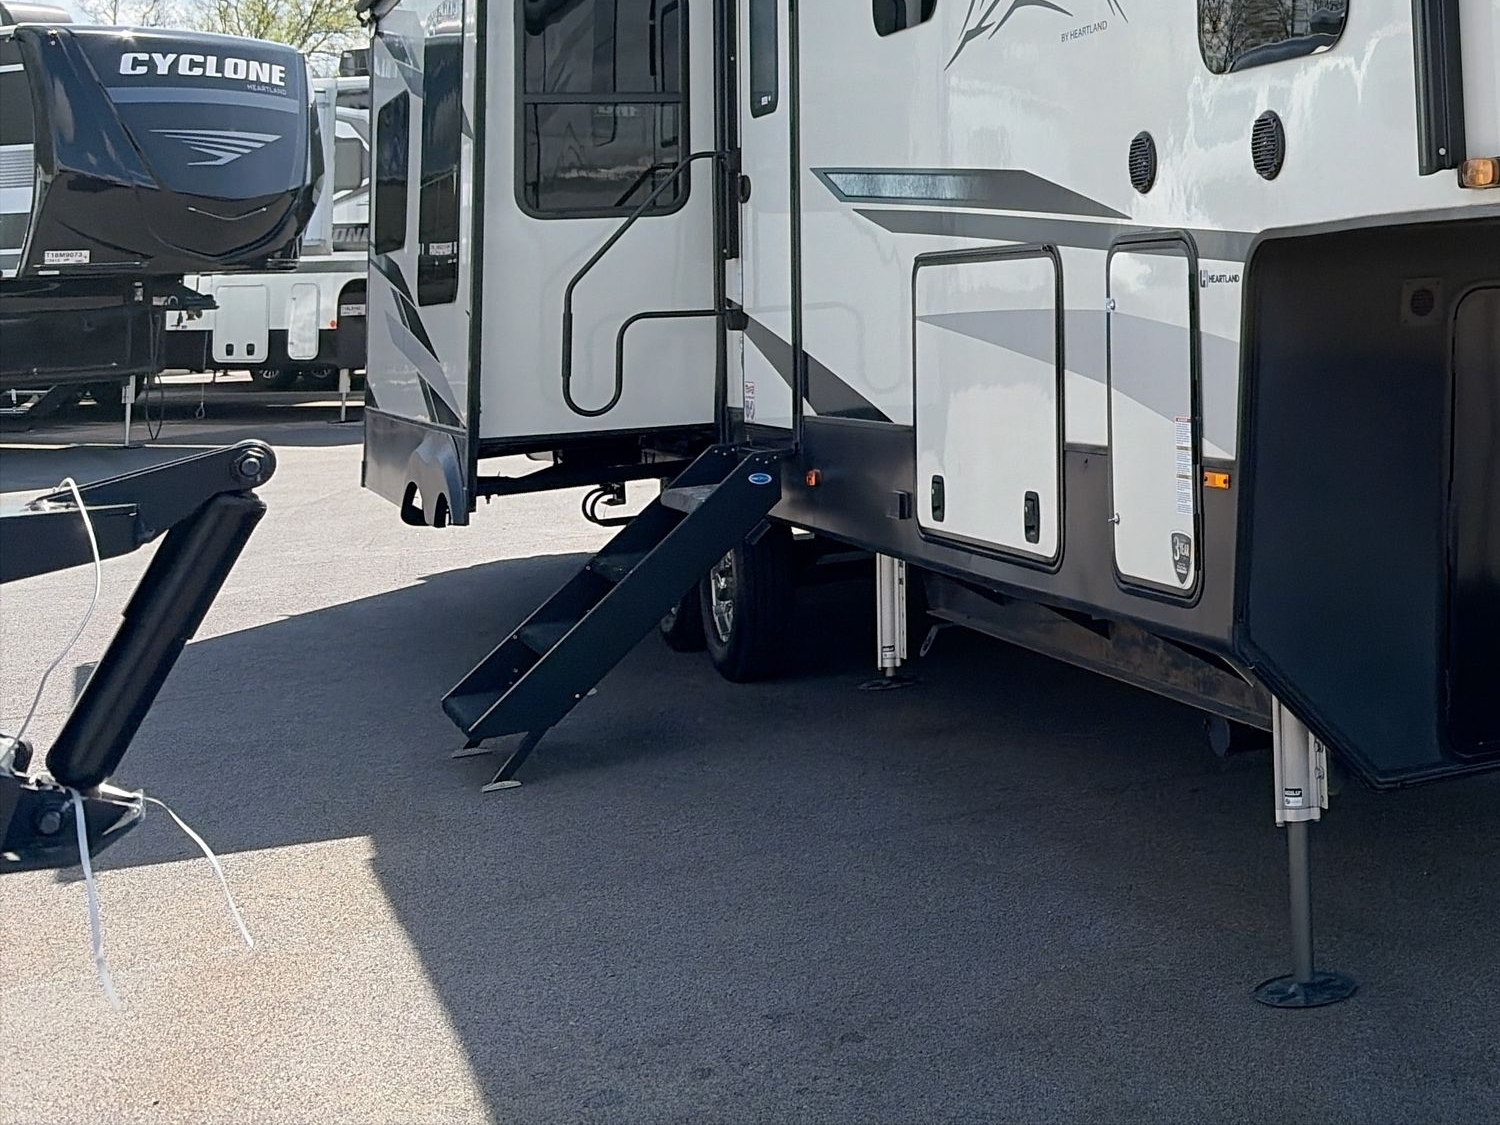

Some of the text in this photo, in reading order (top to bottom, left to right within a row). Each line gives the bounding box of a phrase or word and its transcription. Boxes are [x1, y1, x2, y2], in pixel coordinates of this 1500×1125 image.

[1061, 20, 1108, 43] BY HEARTLAND
[119, 52, 286, 86] CYCLONE
[1208, 274, 1240, 284] HEARTLAND
